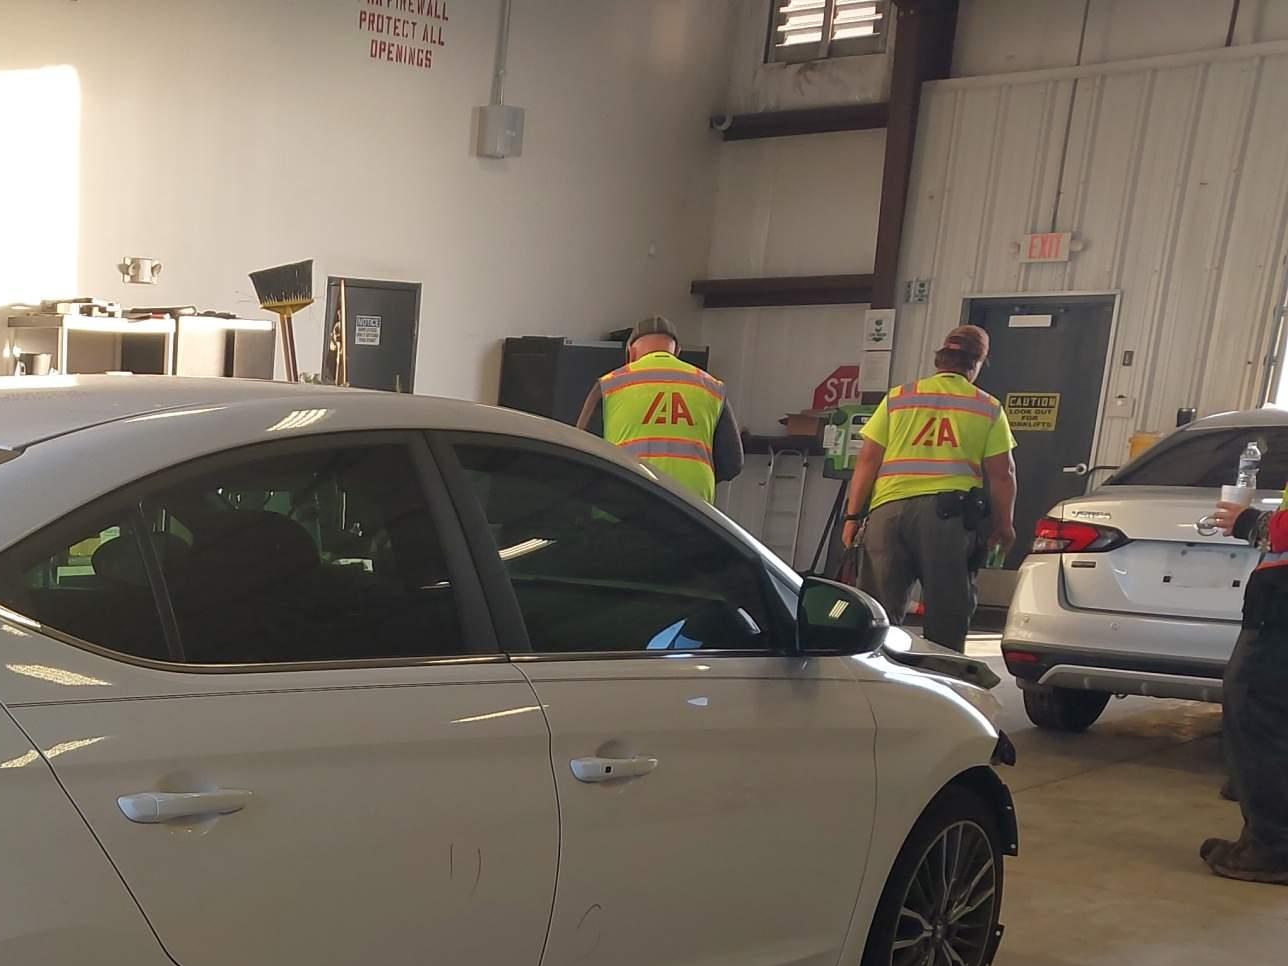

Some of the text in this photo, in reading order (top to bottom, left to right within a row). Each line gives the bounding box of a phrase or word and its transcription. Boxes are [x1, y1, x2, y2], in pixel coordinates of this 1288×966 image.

[359, 10, 445, 46] PROTECT ALL
[370, 39, 432, 69] OPENINGS
[1028, 233, 1064, 259] EXIT
[1009, 397, 1056, 407] CAUTION
